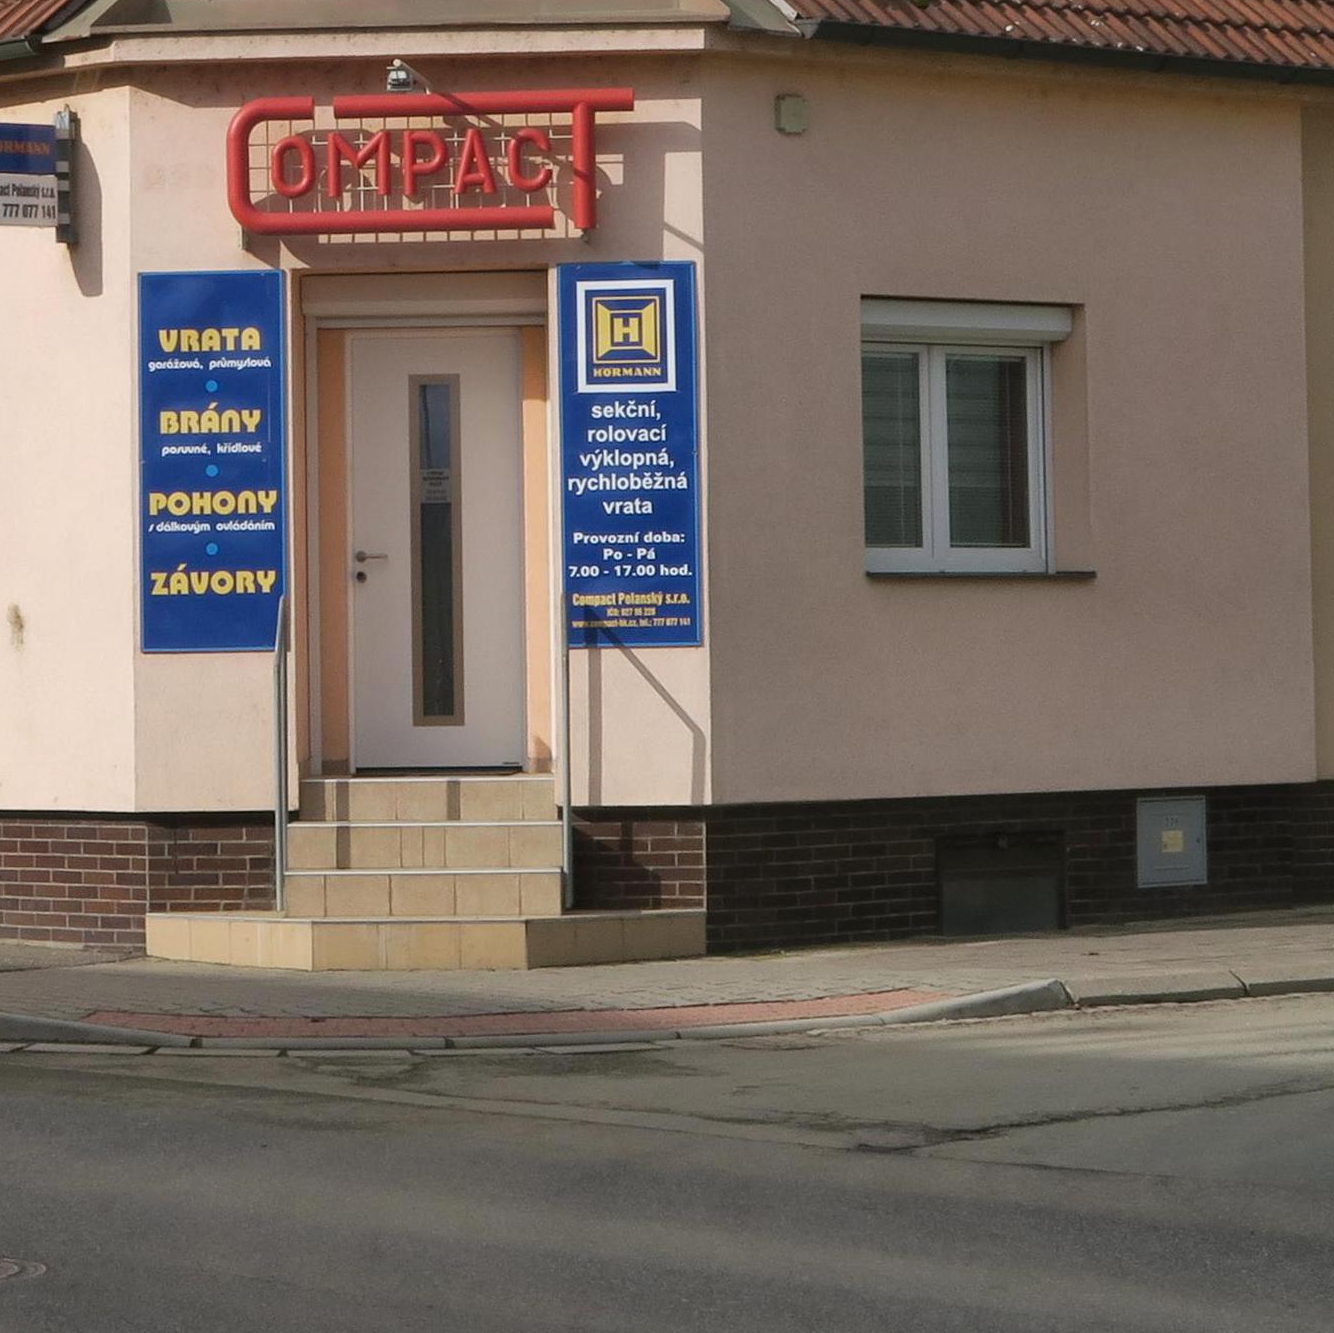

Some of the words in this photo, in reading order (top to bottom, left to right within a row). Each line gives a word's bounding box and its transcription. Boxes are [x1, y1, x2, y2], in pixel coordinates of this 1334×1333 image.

[227, 88, 634, 235] COMPACT
[2, 203, 20, 218] 777
[22, 204, 39, 219] 077
[41, 204, 56, 219] 141
[158, 327, 261, 352] VRATA
[148, 358, 204, 372] garážová,
[209, 356, 272, 371] průmyslová
[159, 402, 261, 434] BRÁNY
[591, 401, 661, 420] sekční,
[587, 424, 666, 443] rolovací
[161, 442, 212, 457] posuvné,
[217, 441, 262, 454] křídlové
[579, 448, 674, 471] výklopná,
[568, 472, 688, 496] rychloběžná
[149, 490, 277, 516] POHONY
[602, 498, 653, 515] vrata
[156, 520, 211, 534] dálkovým
[216, 519, 275, 531] ovládáním
[573, 532, 641, 544] Provozní
[643, 531, 685, 543] doba:
[603, 548, 623, 560] Po
[636, 547, 656, 560] Pá
[150, 563, 276, 595] ZÁVORY
[569, 565, 600, 577] 7.00
[614, 565, 656, 576] 17.00
[659, 563, 693, 576] hod.
[572, 593, 616, 606] Compact
[618, 591, 664, 606] Polanský
[665, 593, 690, 605] s.r.o.
